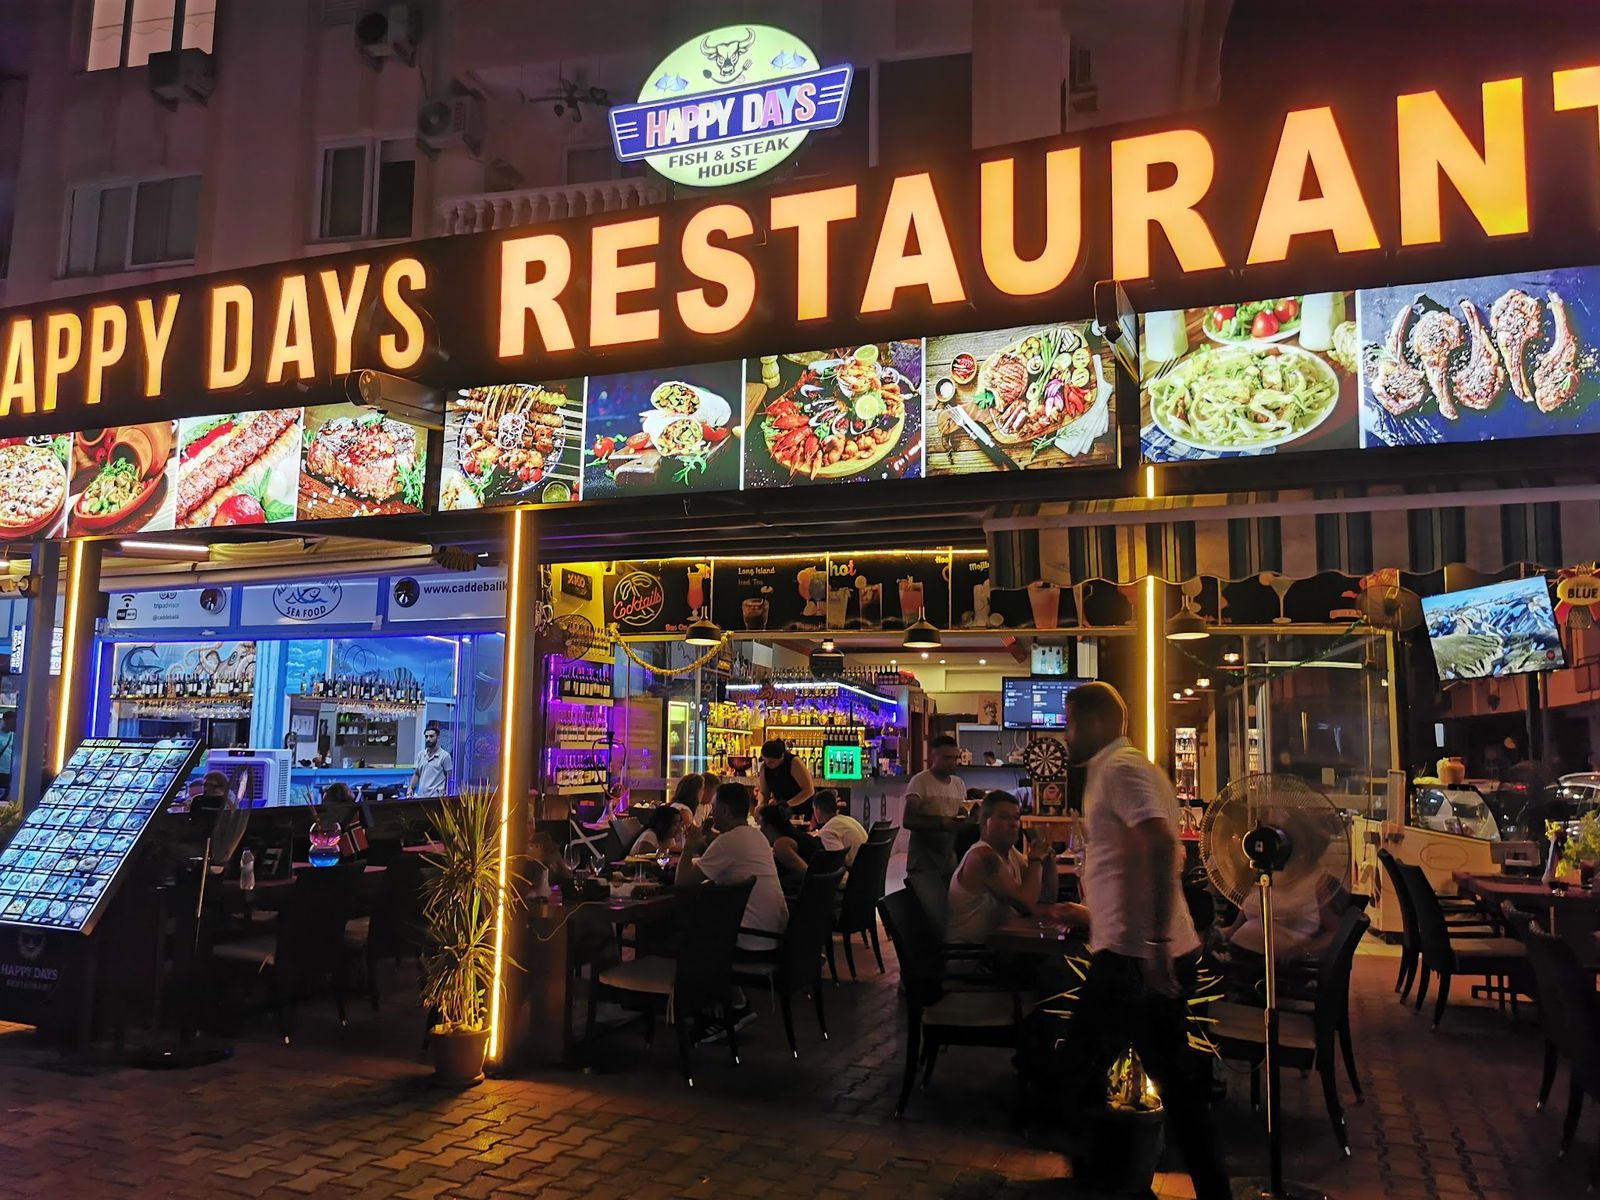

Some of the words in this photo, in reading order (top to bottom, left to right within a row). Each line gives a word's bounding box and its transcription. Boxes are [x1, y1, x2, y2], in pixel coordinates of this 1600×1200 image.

[645, 97, 736, 148] HAPPY
[742, 82, 816, 132] DAYS
[668, 150, 708, 168] FISH
[714, 151, 725, 161] &
[730, 136, 790, 158] STEAK
[698, 158, 758, 179] HOUSE
[0, 293, 181, 416] APPY
[208, 259, 429, 390] DAYS
[738, 567, 755, 576] Long
[756, 566, 775, 574] Island
[829, 559, 857, 577] hot
[1567, 587, 1599, 599] BLUE
[153, 601, 180, 610] tripadvisor
[612, 586, 662, 619] Cocktails
[286, 606, 301, 618] SEA
[303, 605, 326, 618] FOOD
[94, 739, 121, 748] STARTER
[0, 963, 32, 977] HAPPY
[33, 966, 59, 980] DAYS
